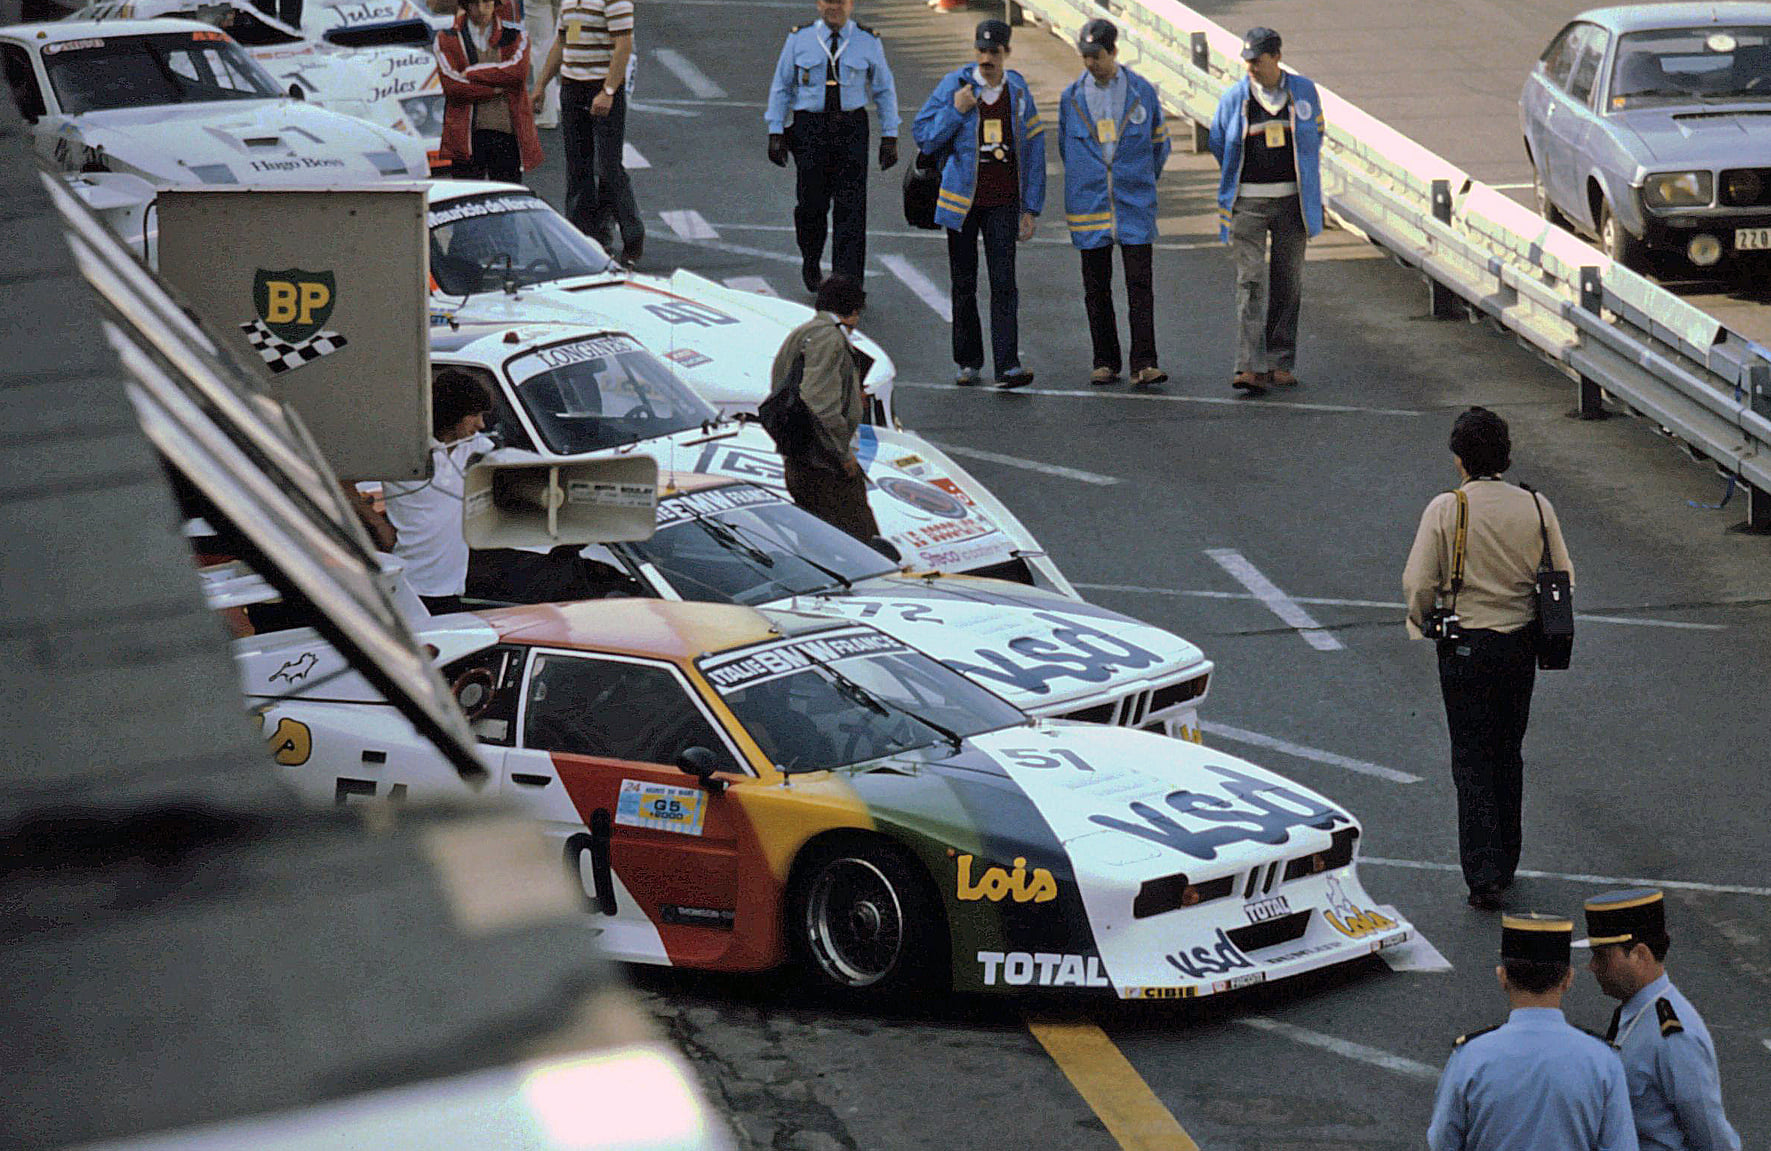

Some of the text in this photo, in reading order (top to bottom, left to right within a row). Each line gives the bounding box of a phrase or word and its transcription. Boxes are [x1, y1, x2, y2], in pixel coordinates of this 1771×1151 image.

[322, 4, 394, 29] Jules
[381, 54, 430, 78] Jules
[366, 77, 417, 104] Jules
[250, 157, 345, 172] Hugo Boss
[265, 281, 330, 325] BP
[643, 301, 740, 327] 40
[536, 336, 632, 368] LONGINES
[660, 489, 738, 519] BMW
[706, 635, 899, 686] ITALIE BMW FRANCE
[999, 748, 1096, 772] 51
[623, 781, 641, 792] 24
[957, 854, 1058, 903] Lois
[1245, 896, 1292, 923] TOTAL
[977, 951, 1109, 987] TOTAL
[1144, 986, 1196, 998] CIBIE
